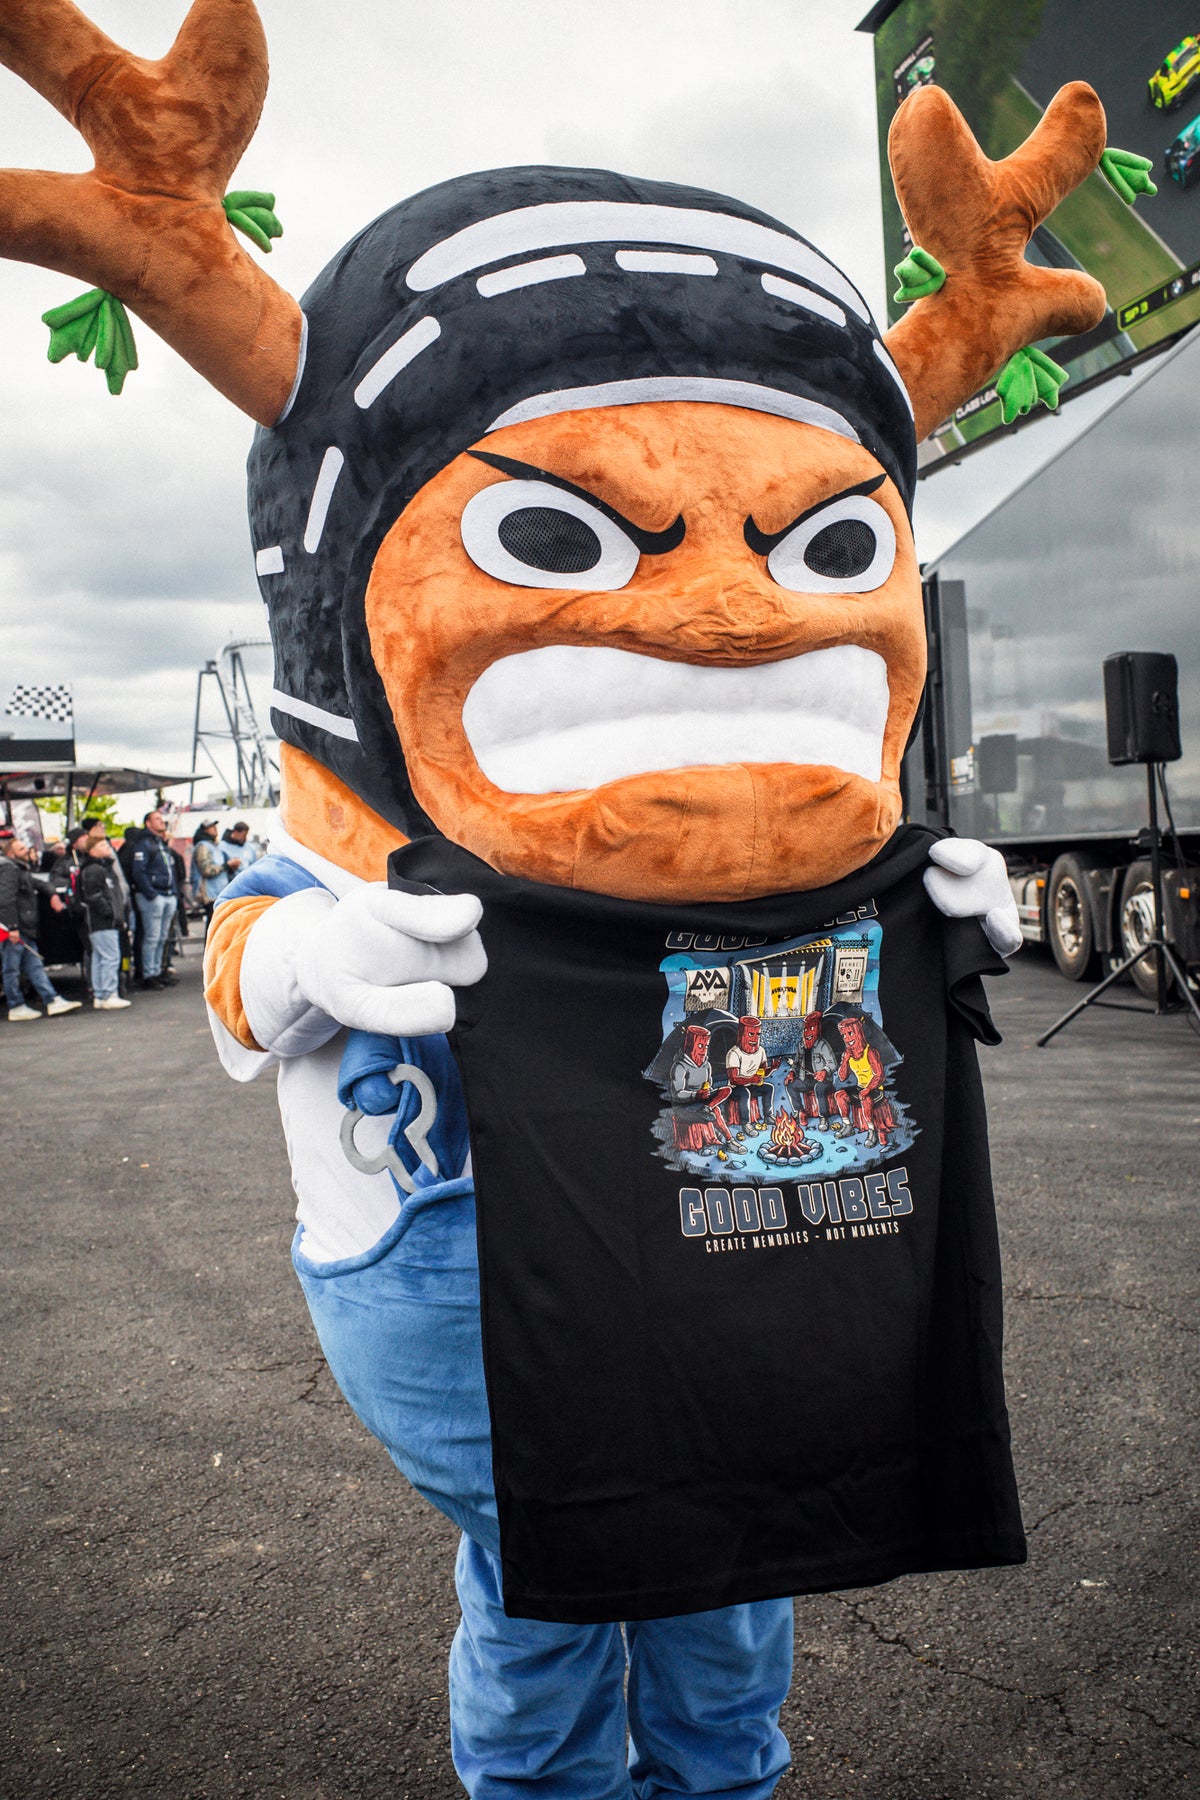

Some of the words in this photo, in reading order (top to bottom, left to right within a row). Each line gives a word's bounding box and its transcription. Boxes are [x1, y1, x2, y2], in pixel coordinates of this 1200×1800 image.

[679, 1187, 788, 1237] GOOD
[798, 1166, 914, 1225] VIBES
[705, 1236, 747, 1253] CREATE
[752, 1230, 809, 1249] MEMORIES
[826, 1227, 846, 1241] NOT
[852, 1221, 900, 1238] MOMENTS
